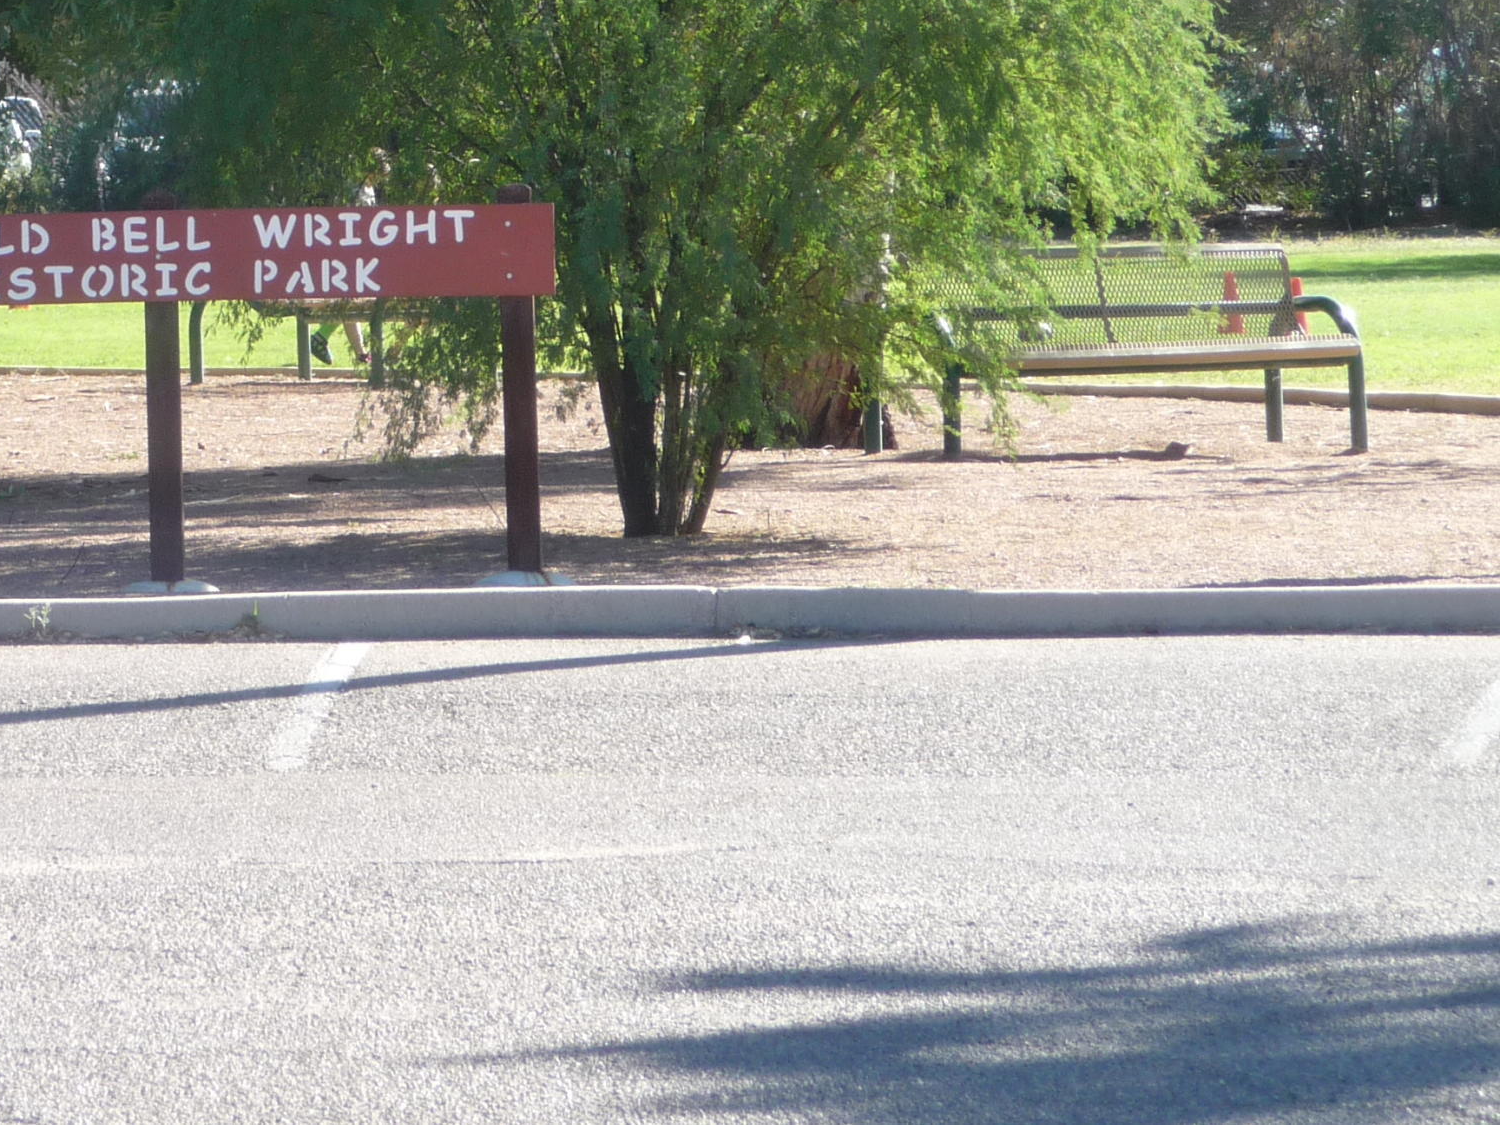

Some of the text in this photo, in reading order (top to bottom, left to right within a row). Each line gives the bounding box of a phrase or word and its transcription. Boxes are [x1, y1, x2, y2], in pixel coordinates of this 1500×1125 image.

[91, 216, 211, 253] BELL
[252, 209, 475, 249] WRIGHT
[253, 257, 381, 294] PARK
